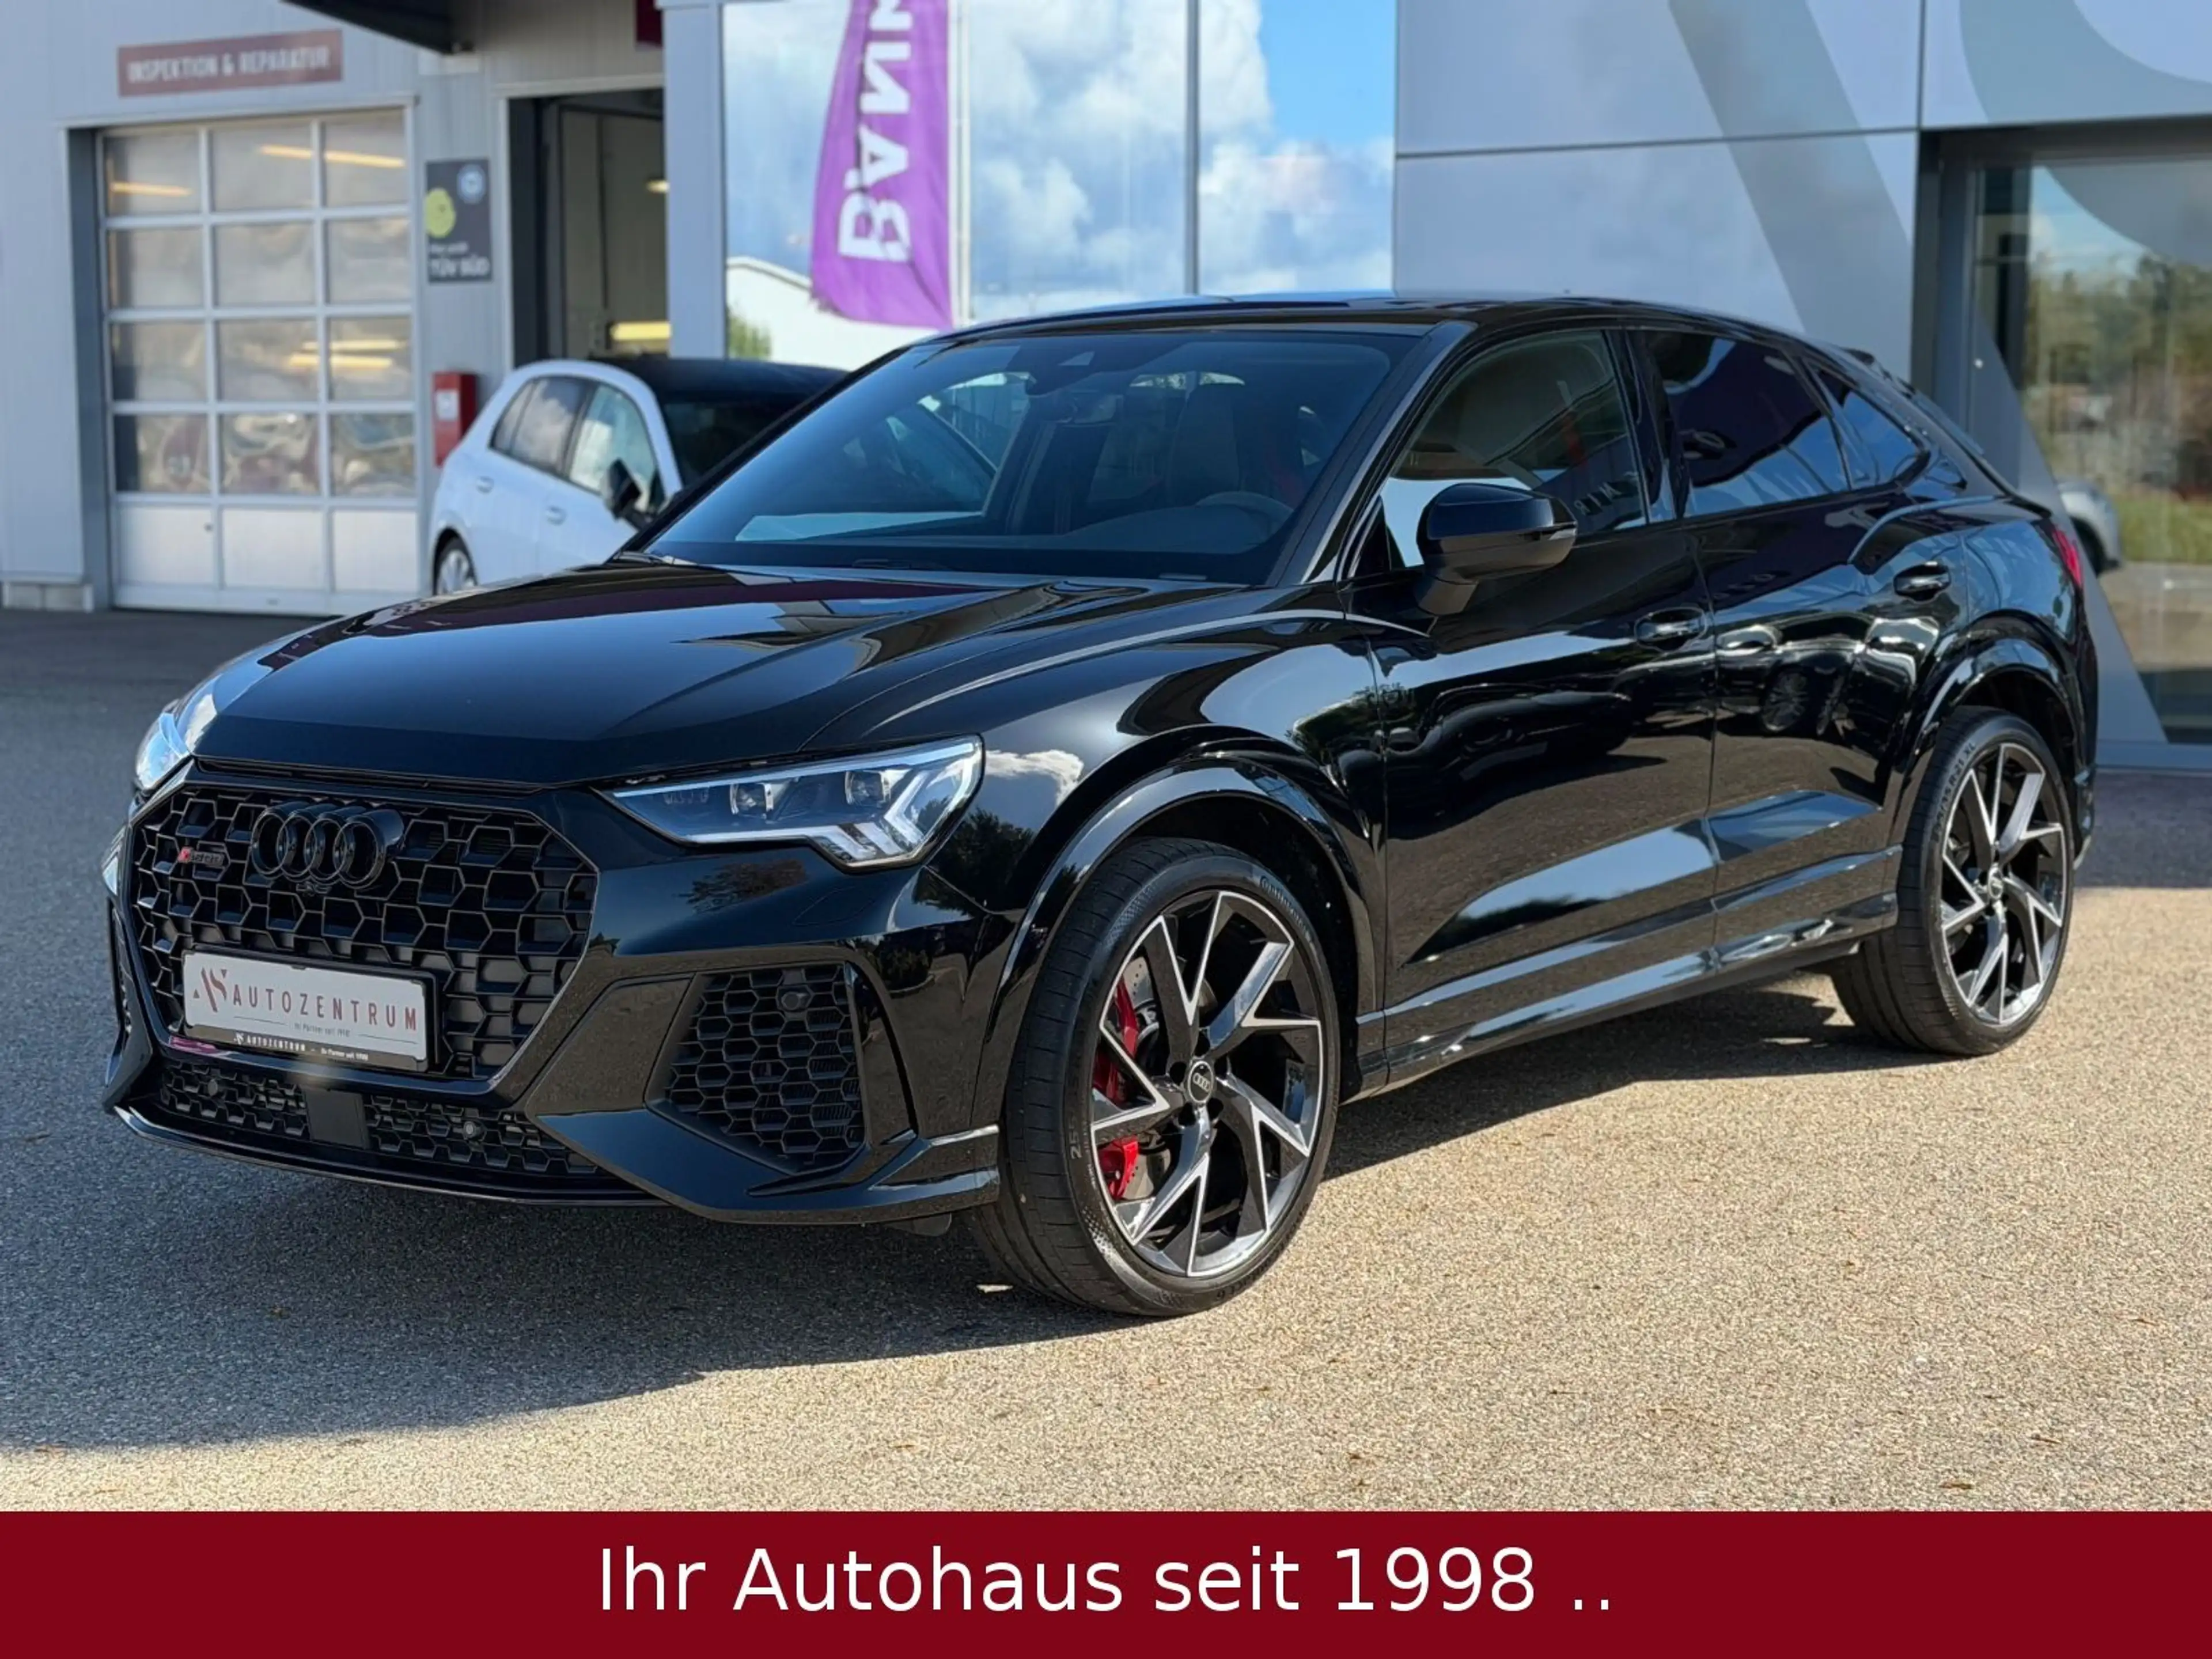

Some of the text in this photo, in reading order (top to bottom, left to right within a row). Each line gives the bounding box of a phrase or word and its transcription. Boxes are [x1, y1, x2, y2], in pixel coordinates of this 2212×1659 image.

[127, 46, 330, 83] INSPEKTION & REPARATUR
[233, 984, 416, 1031] AUTOZENTRUM
[247, 1035, 306, 1052] AUTOZENTRUM
